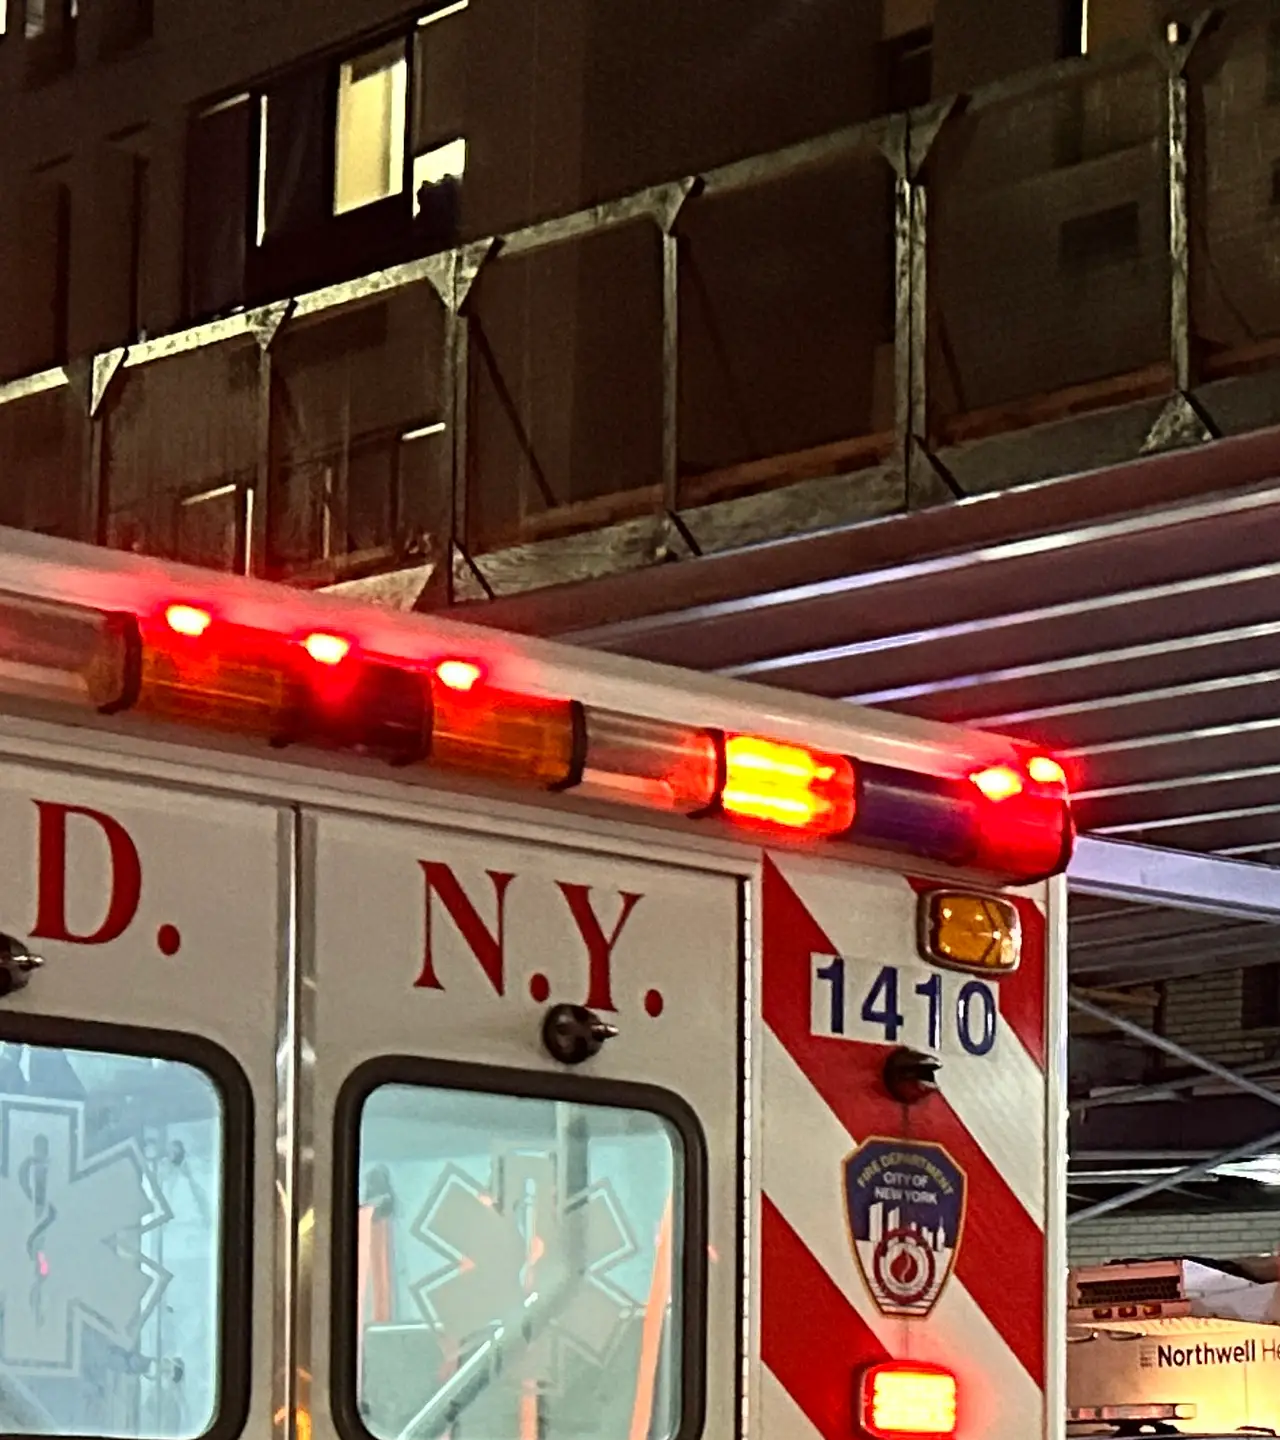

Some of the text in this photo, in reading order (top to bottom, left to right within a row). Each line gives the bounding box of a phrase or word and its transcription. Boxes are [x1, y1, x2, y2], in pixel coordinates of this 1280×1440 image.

[413, 859, 664, 1018] N.Y.
[817, 957, 996, 1056] 1410
[883, 1171, 928, 1188] CITY OF
[875, 1186, 938, 1205] NEW YORK
[1158, 1339, 1256, 1368] Northwell
